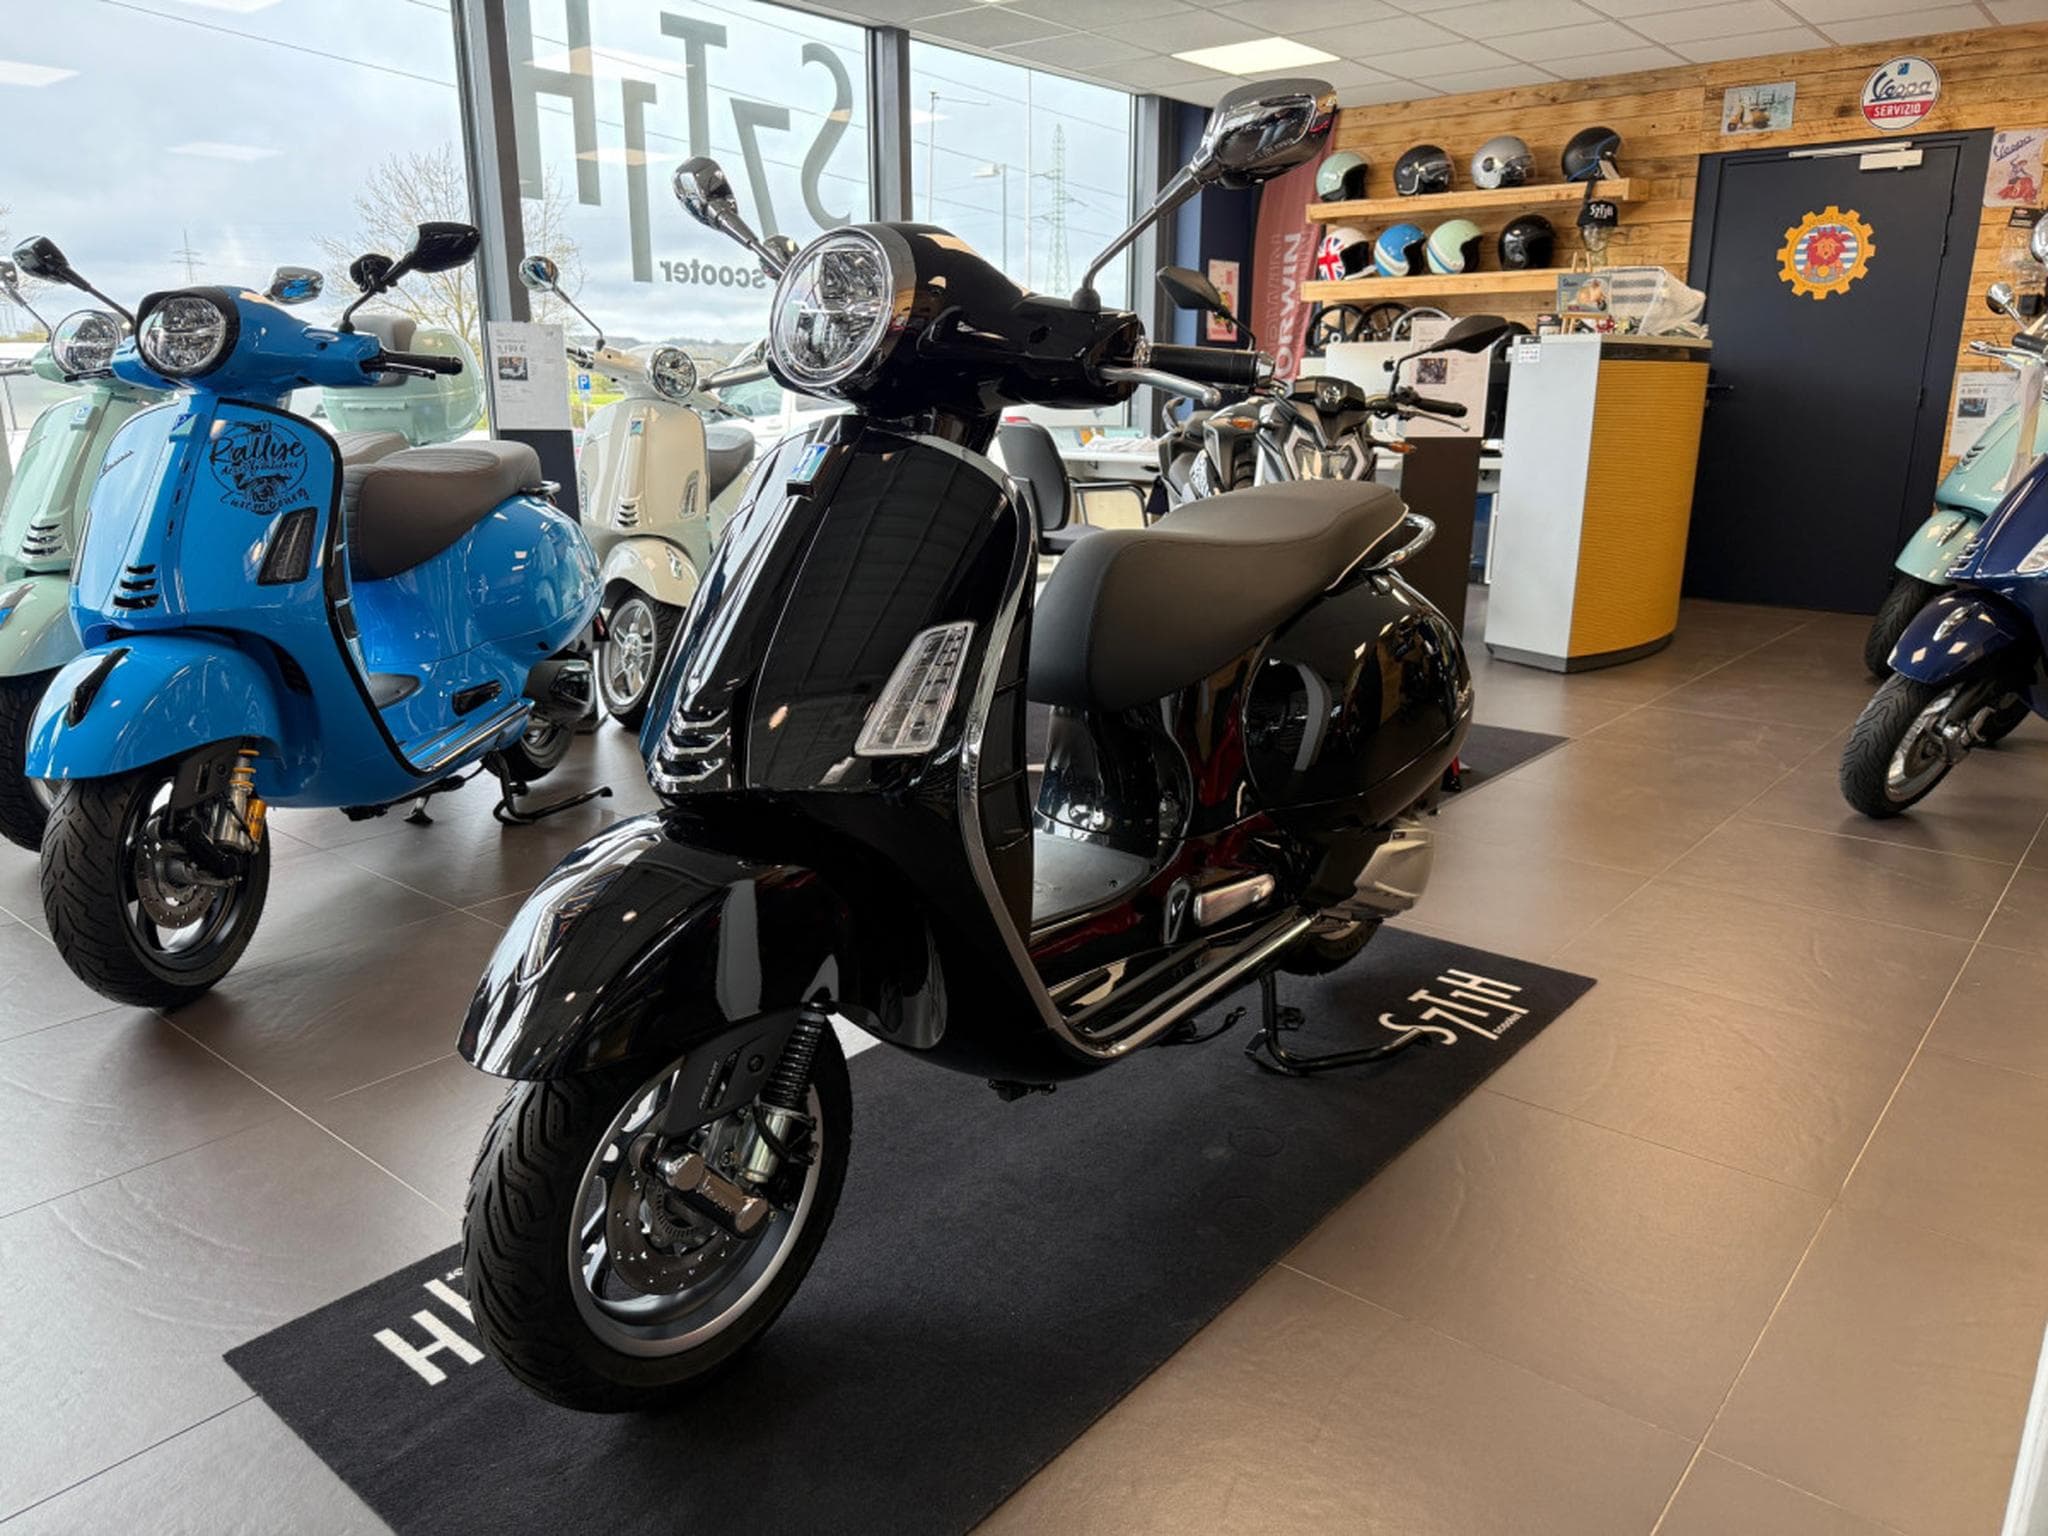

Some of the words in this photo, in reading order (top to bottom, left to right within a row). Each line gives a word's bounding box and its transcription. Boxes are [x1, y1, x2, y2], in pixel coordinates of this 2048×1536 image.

[1870, 71, 1932, 102] Vespa
[1873, 103, 1922, 118] SERVIZIO
[1275, 233, 1301, 378] ORWIN
[210, 434, 305, 465] Rallye
